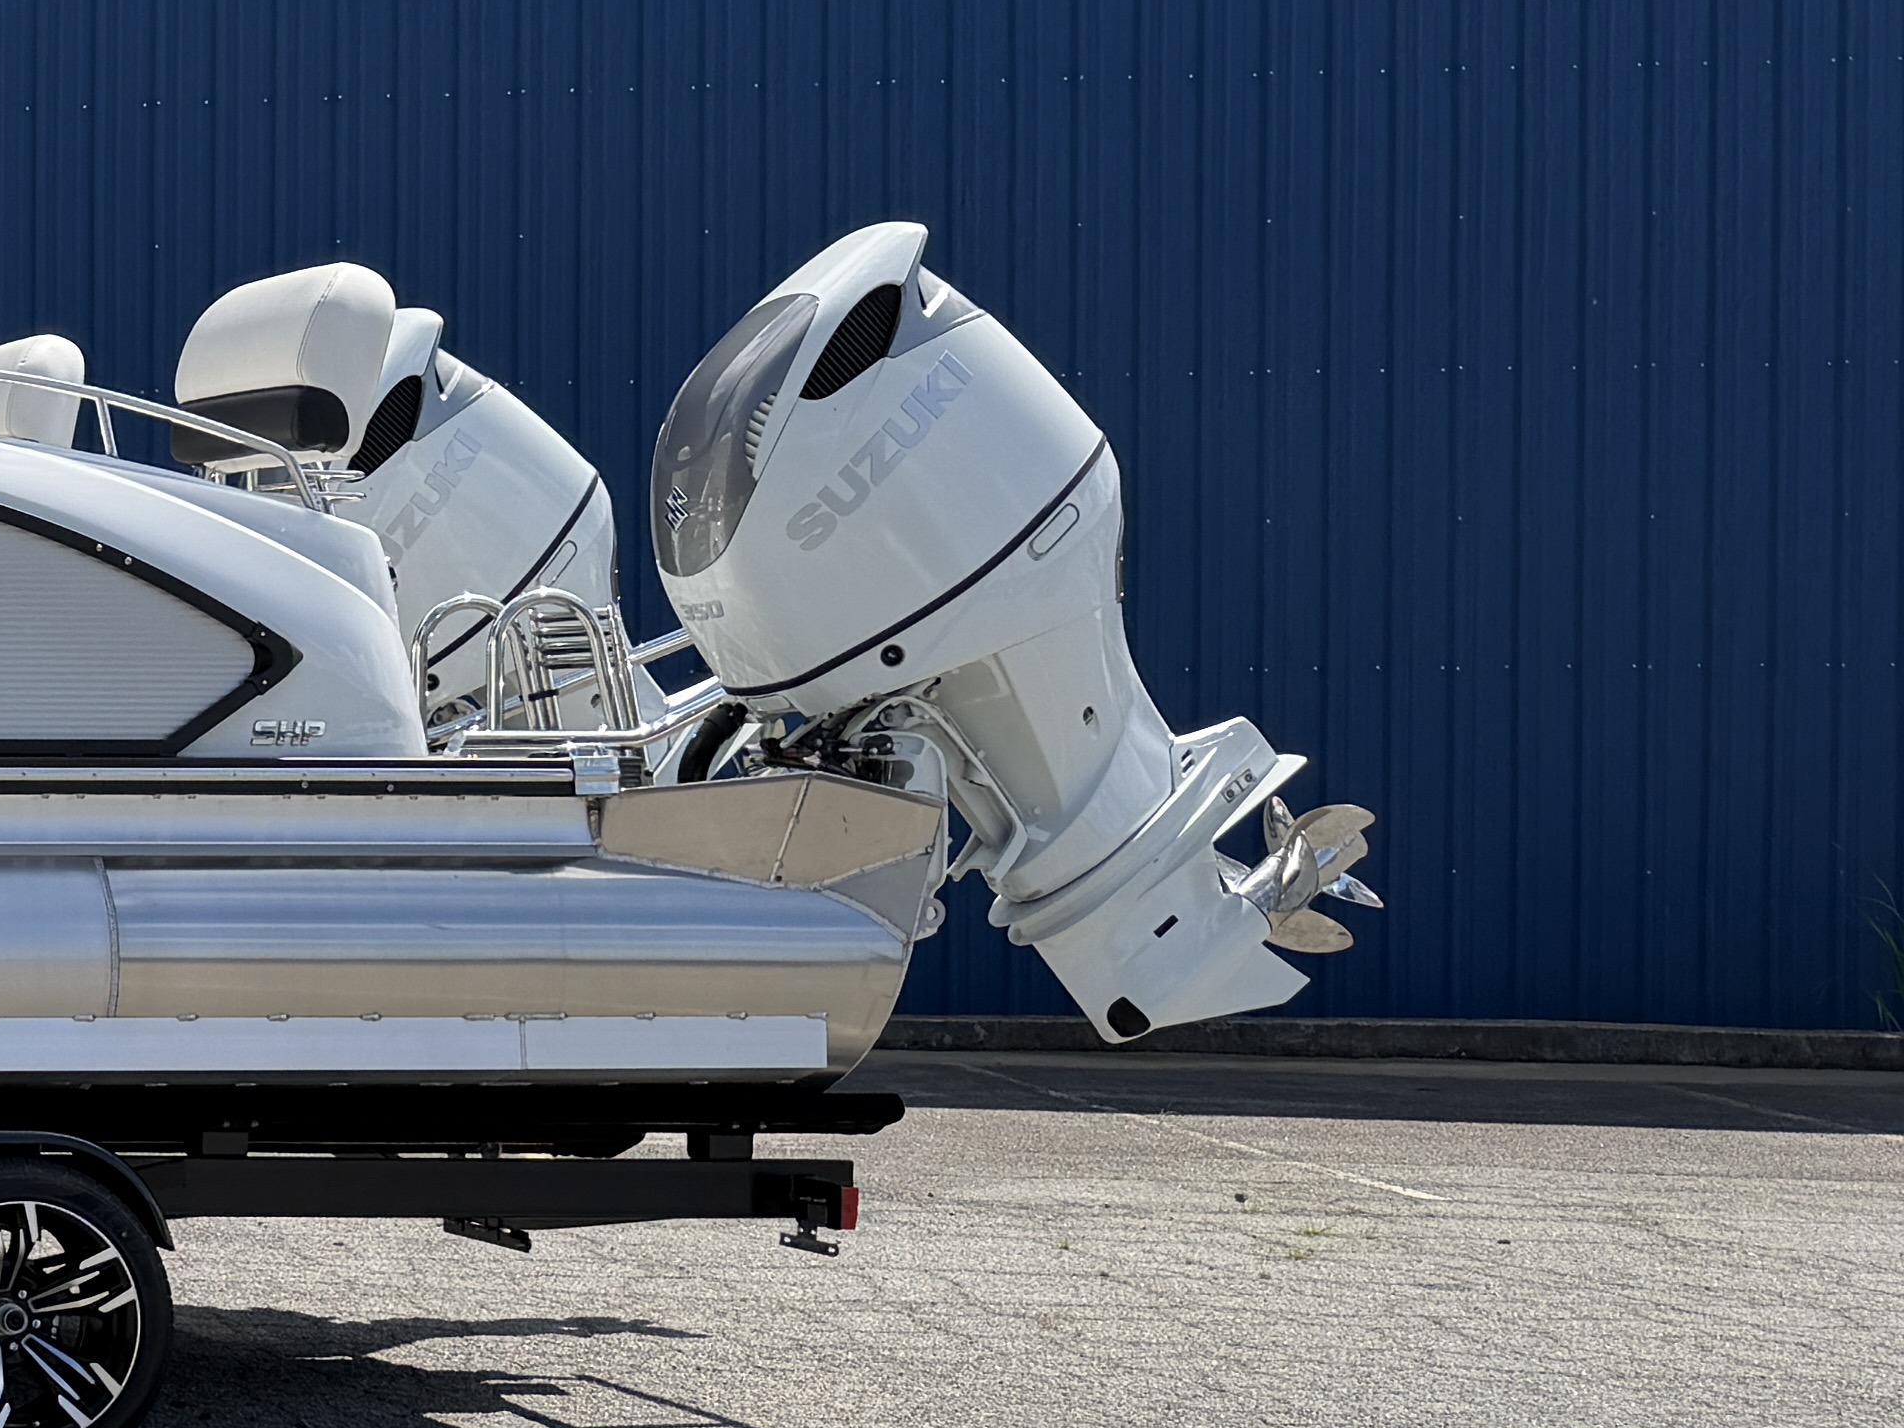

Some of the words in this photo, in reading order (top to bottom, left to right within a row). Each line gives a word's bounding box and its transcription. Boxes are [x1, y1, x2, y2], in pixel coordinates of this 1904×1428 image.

[786, 349, 973, 551] SUZUKI
[379, 427, 483, 566] ZUKI
[679, 599, 725, 622] 350
[250, 719, 326, 746] SHP
